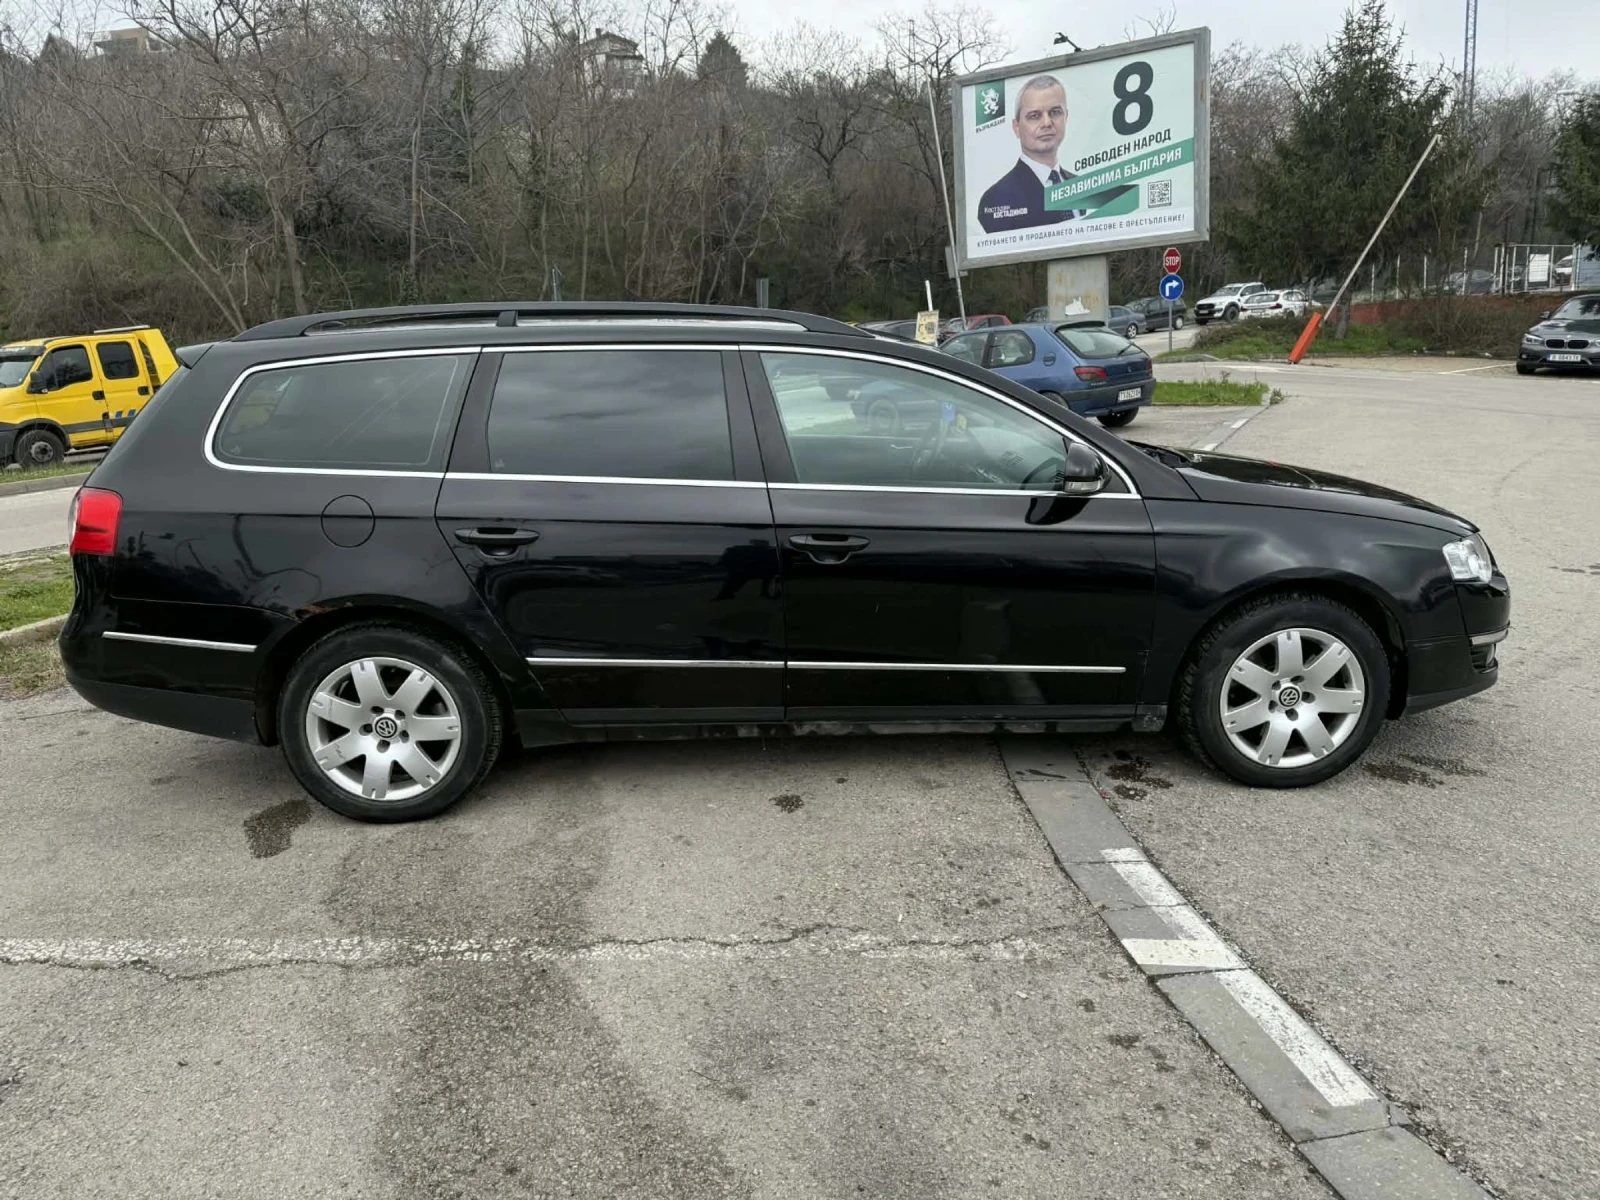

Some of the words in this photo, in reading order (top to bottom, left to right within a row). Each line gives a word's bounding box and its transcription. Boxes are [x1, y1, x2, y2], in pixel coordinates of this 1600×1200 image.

[1112, 61, 1154, 136] 8
[1074, 142, 1131, 172] СВОБОДЕН
[1134, 128, 1171, 152] НАРОД
[1051, 168, 1122, 202] НЕЗАВИСИМА
[1124, 147, 1182, 177] БЪЛГАРИЯ
[977, 235, 1017, 248] КУПУВАНЕТО
[1026, 228, 1073, 241] ПРОДАВАНЕТО
[1075, 226, 1084, 234] НА
[1086, 222, 1117, 232] ГЛАСОВЕ
[1119, 221, 1124, 229] Е
[1126, 213, 1185, 228] ПРЕСТЪПЛЕНИЕ!
[1165, 256, 1180, 266] STOP
